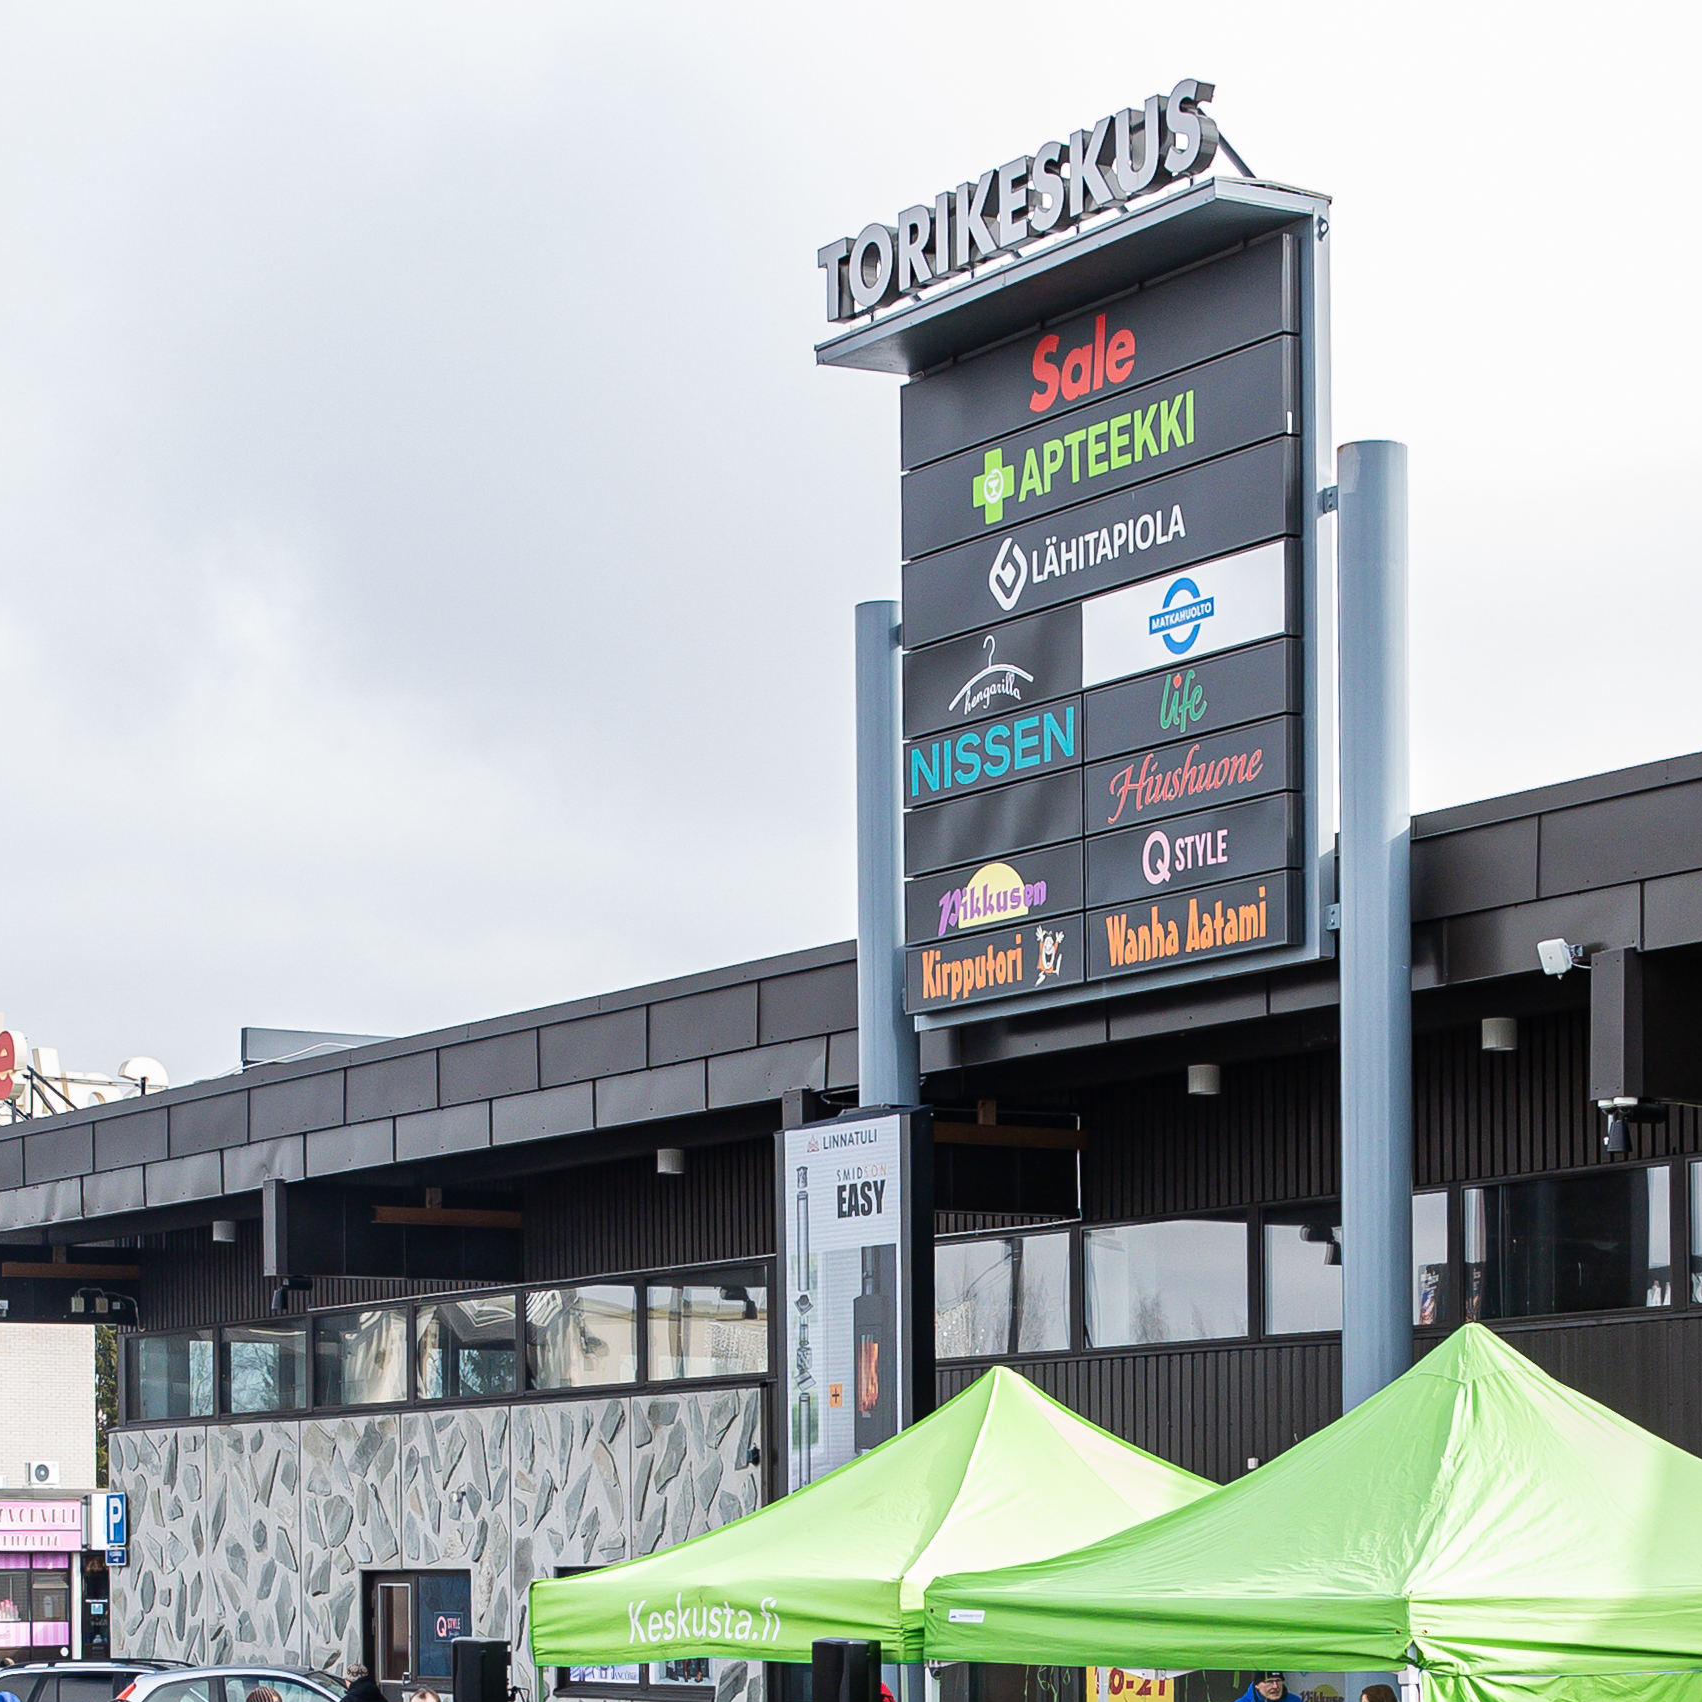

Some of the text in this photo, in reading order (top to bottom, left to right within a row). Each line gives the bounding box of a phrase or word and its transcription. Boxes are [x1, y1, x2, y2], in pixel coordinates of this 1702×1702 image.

[818, 79, 1215, 322] TORIKESKUS
[1029, 313, 1137, 413] Sale
[1018, 389, 1195, 503] APTEEKKI
[1031, 503, 1186, 585] LÄHITAPIOLA
[1151, 600, 1213, 632] MATKAHUOLTO
[1160, 668, 1207, 733] life
[911, 705, 1075, 797] NISSEN
[1107, 743, 1264, 825] Hiushuone
[1141, 828, 1228, 886] Q STYLE
[937, 879, 1047, 937] Pikkusen
[1105, 885, 1267, 967] Wanha Aatami
[921, 933, 1023, 1002] Kirpputori
[822, 1128, 877, 1150] LINNATULI
[836, 1179, 886, 1219] EASY
[628, 1592, 782, 1645] Keskusta.fi
